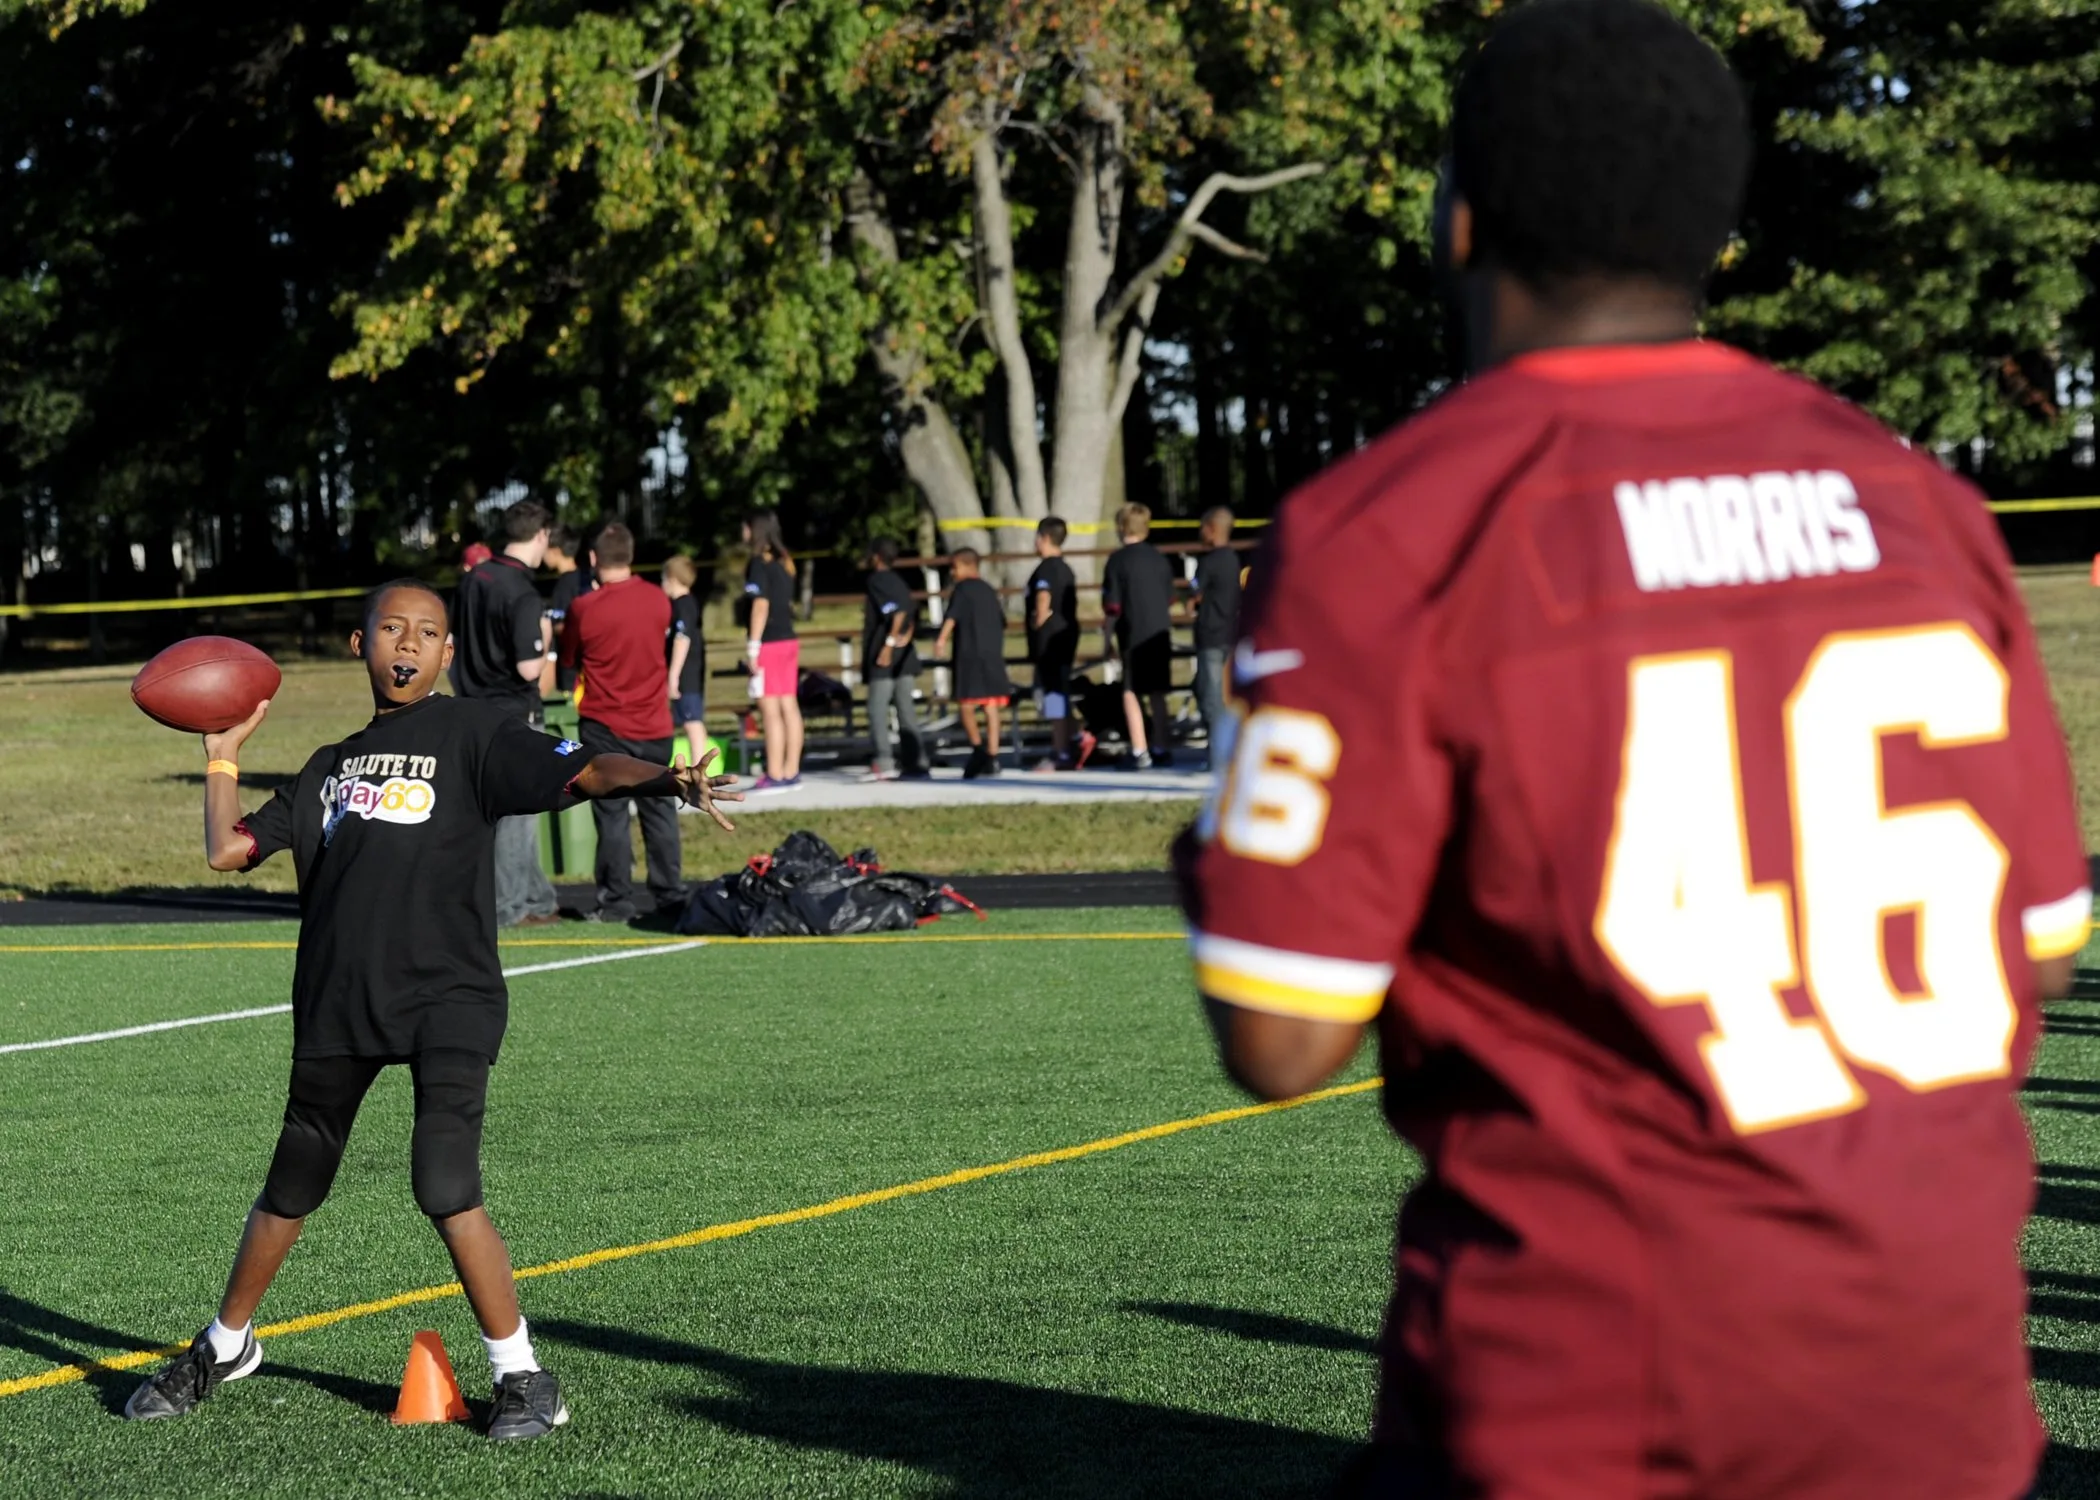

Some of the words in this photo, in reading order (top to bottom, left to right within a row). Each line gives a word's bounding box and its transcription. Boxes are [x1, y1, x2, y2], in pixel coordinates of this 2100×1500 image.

[339, 753, 408, 780] SALUTE
[408, 754, 437, 779] TO
[1592, 620, 2019, 1136] 46
